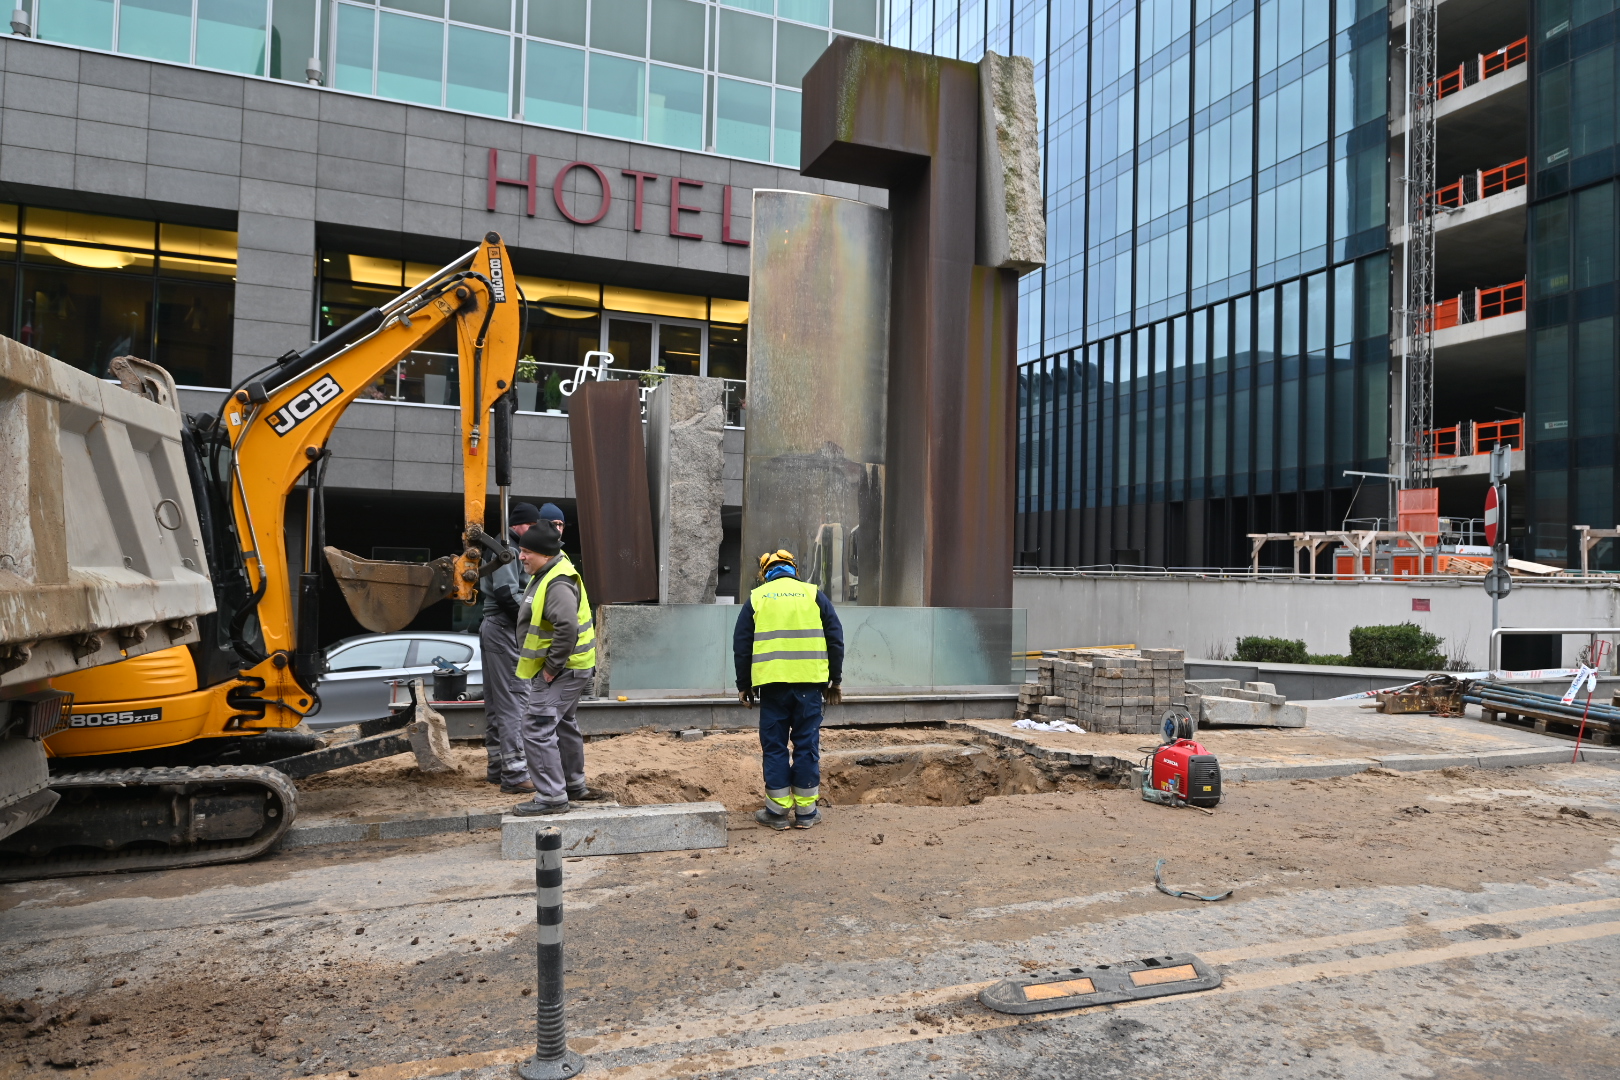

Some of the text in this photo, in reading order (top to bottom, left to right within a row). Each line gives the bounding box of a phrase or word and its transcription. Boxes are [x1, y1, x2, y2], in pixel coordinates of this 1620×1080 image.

[487, 148, 750, 246] HOTEL
[275, 377, 340, 433] JCB
[1163, 758, 1178, 767] HONDA
